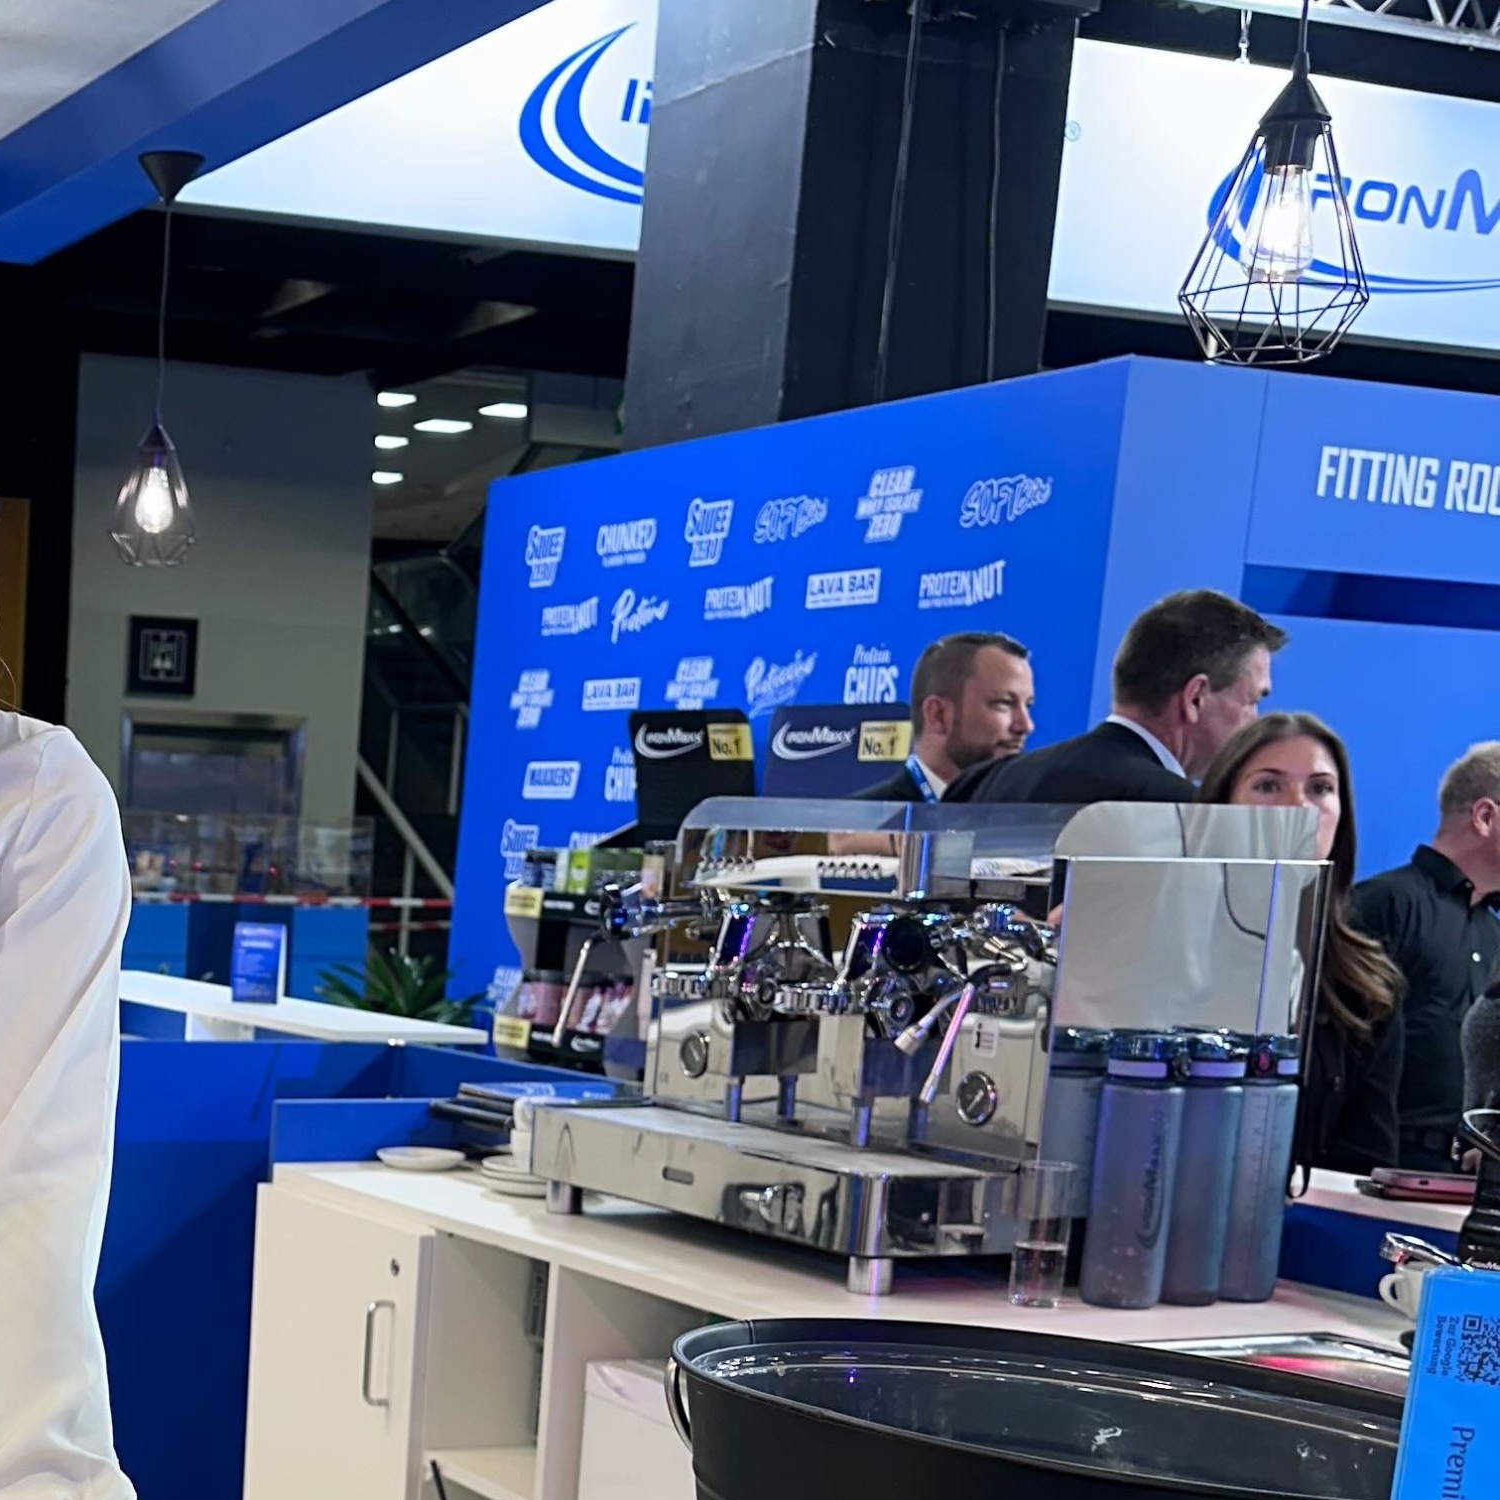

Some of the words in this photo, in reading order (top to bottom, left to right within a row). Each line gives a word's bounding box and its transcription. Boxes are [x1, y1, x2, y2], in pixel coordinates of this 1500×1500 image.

[1316, 445, 1440, 509] FITTING
[810, 576, 845, 596] LAVA
[848, 573, 877, 593] BAR
[844, 666, 899, 704] CHIPS
[863, 738, 884, 755] No.
[1427, 1315, 1447, 1375] Bewertung
[1441, 1337, 1457, 1377] Google
